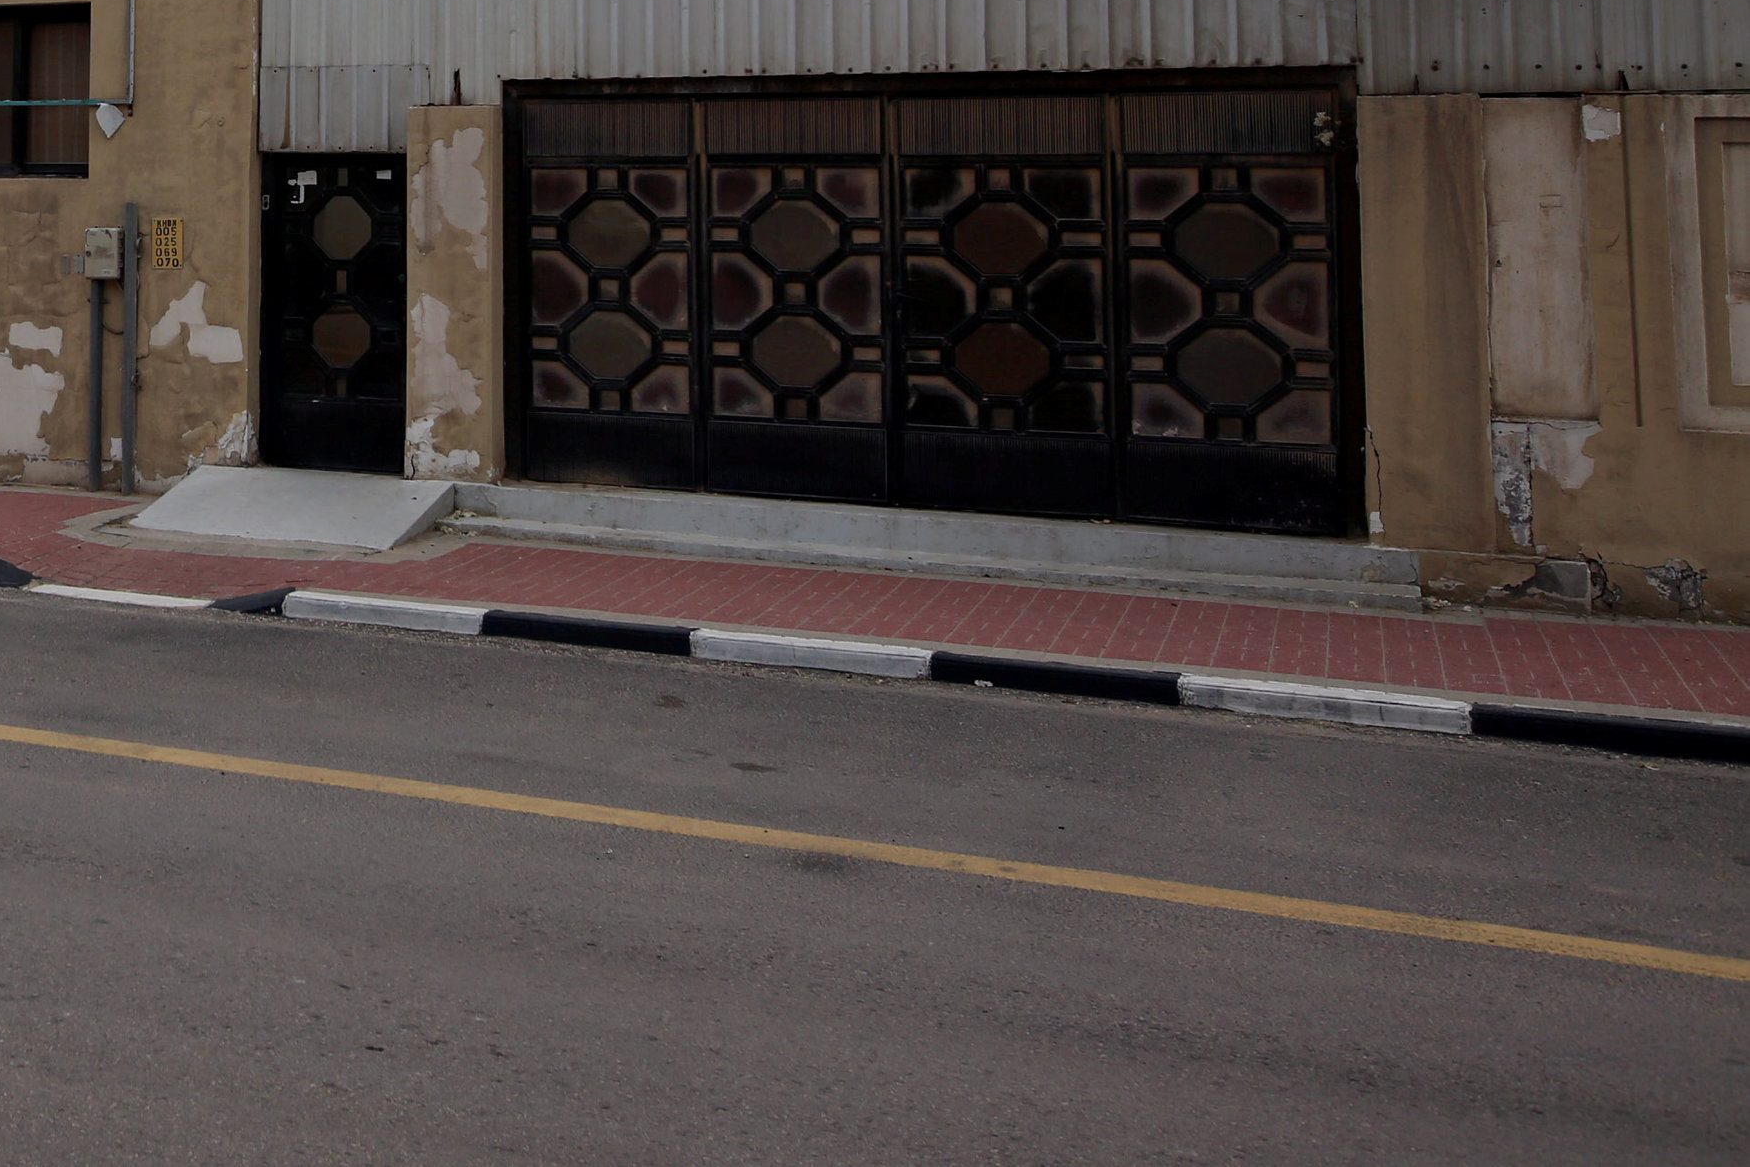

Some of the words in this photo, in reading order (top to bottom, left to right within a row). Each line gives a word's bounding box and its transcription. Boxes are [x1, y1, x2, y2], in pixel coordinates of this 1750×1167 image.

[155, 227, 177, 237] 005
[155, 237, 177, 247] 025
[155, 248, 178, 257] 069
[156, 257, 179, 267] 070
